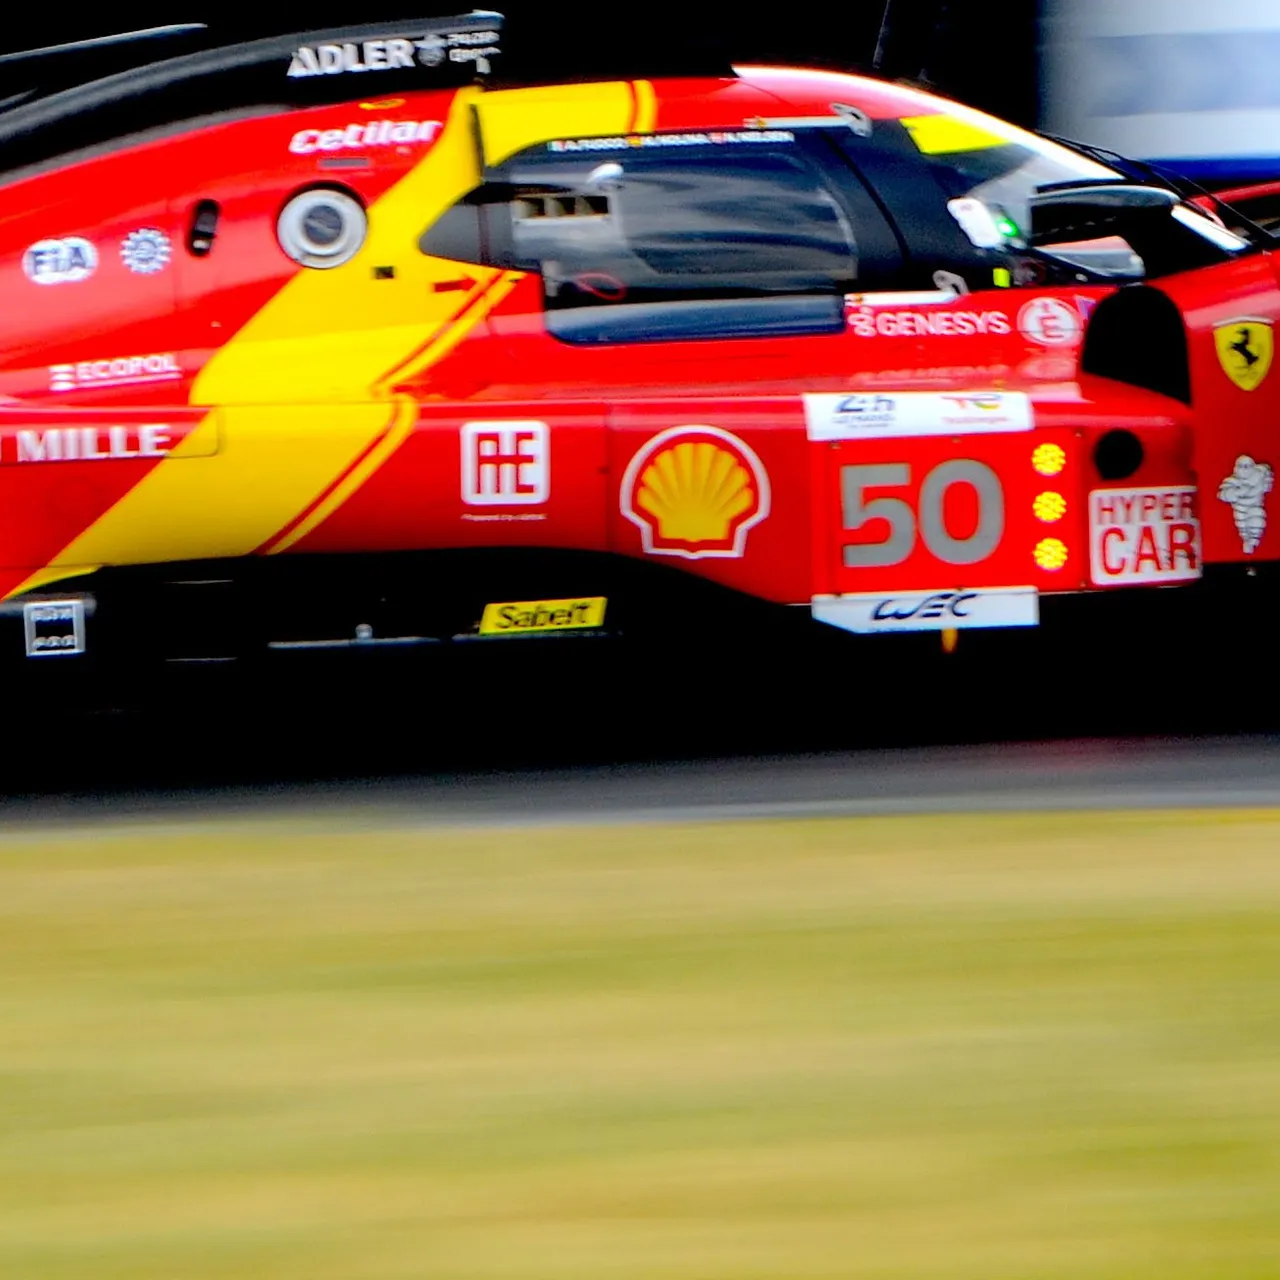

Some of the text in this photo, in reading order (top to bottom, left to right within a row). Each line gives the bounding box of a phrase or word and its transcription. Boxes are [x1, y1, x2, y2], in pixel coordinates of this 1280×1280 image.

[286, 38, 416, 78] ADLER
[288, 119, 444, 154] Cetilar
[876, 310, 1011, 337] GENESYS
[76, 352, 181, 381] ECOPOL
[16, 423, 173, 463] MILLE
[839, 458, 1005, 568] 50
[1096, 492, 1197, 526] HYPER
[1099, 523, 1198, 576] CAR
[495, 602, 590, 629] Sabelt
[871, 592, 978, 622] WEC
